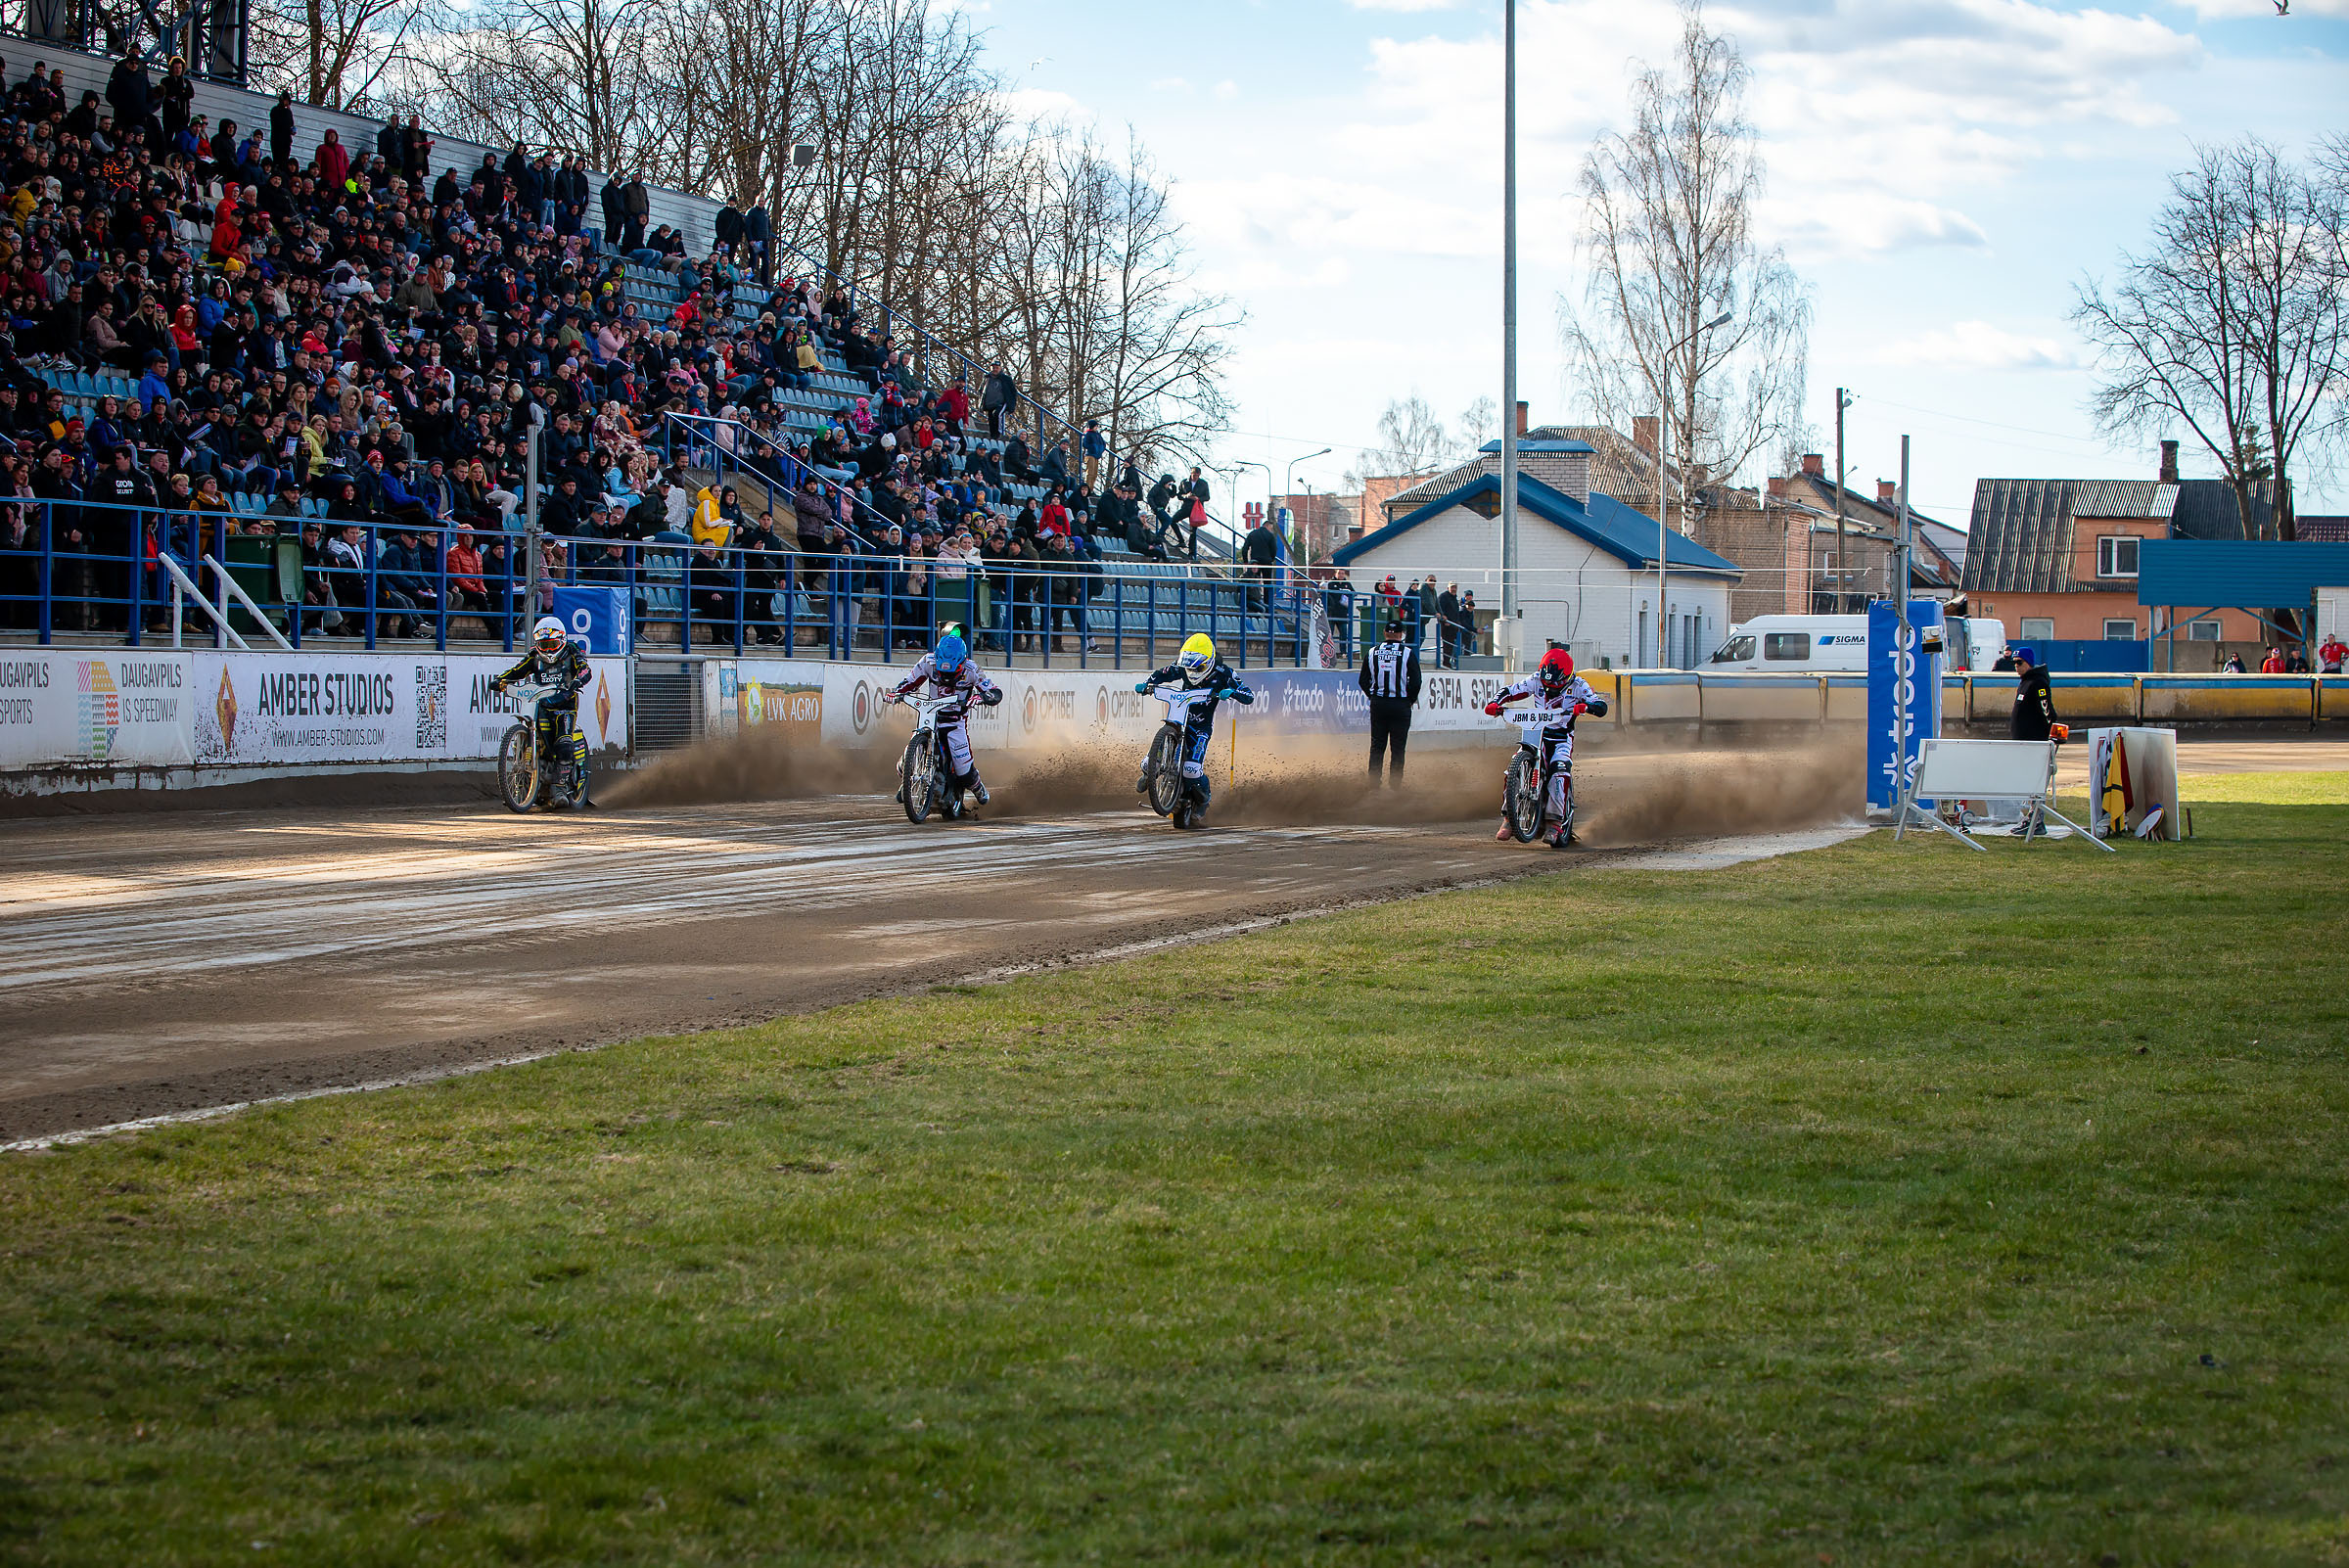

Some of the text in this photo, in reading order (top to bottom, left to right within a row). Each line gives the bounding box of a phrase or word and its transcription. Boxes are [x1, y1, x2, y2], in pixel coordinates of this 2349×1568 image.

[121, 663, 182, 688] DAUGAVPILS
[258, 672, 394, 716] AMBER STUDIOS
[1039, 690, 1076, 720] OPTIBET
[1111, 690, 1144, 718] OPTIBET
[1294, 683, 1324, 713] trodo
[1429, 677, 1463, 710] SOFIA
[122, 698, 178, 722] IS SPEEDWAY
[766, 697, 819, 721] LVK AGRO
[1513, 714, 1529, 722] JBM
[272, 728, 385, 747] WWW.AMBER-STUDIOS.COM
